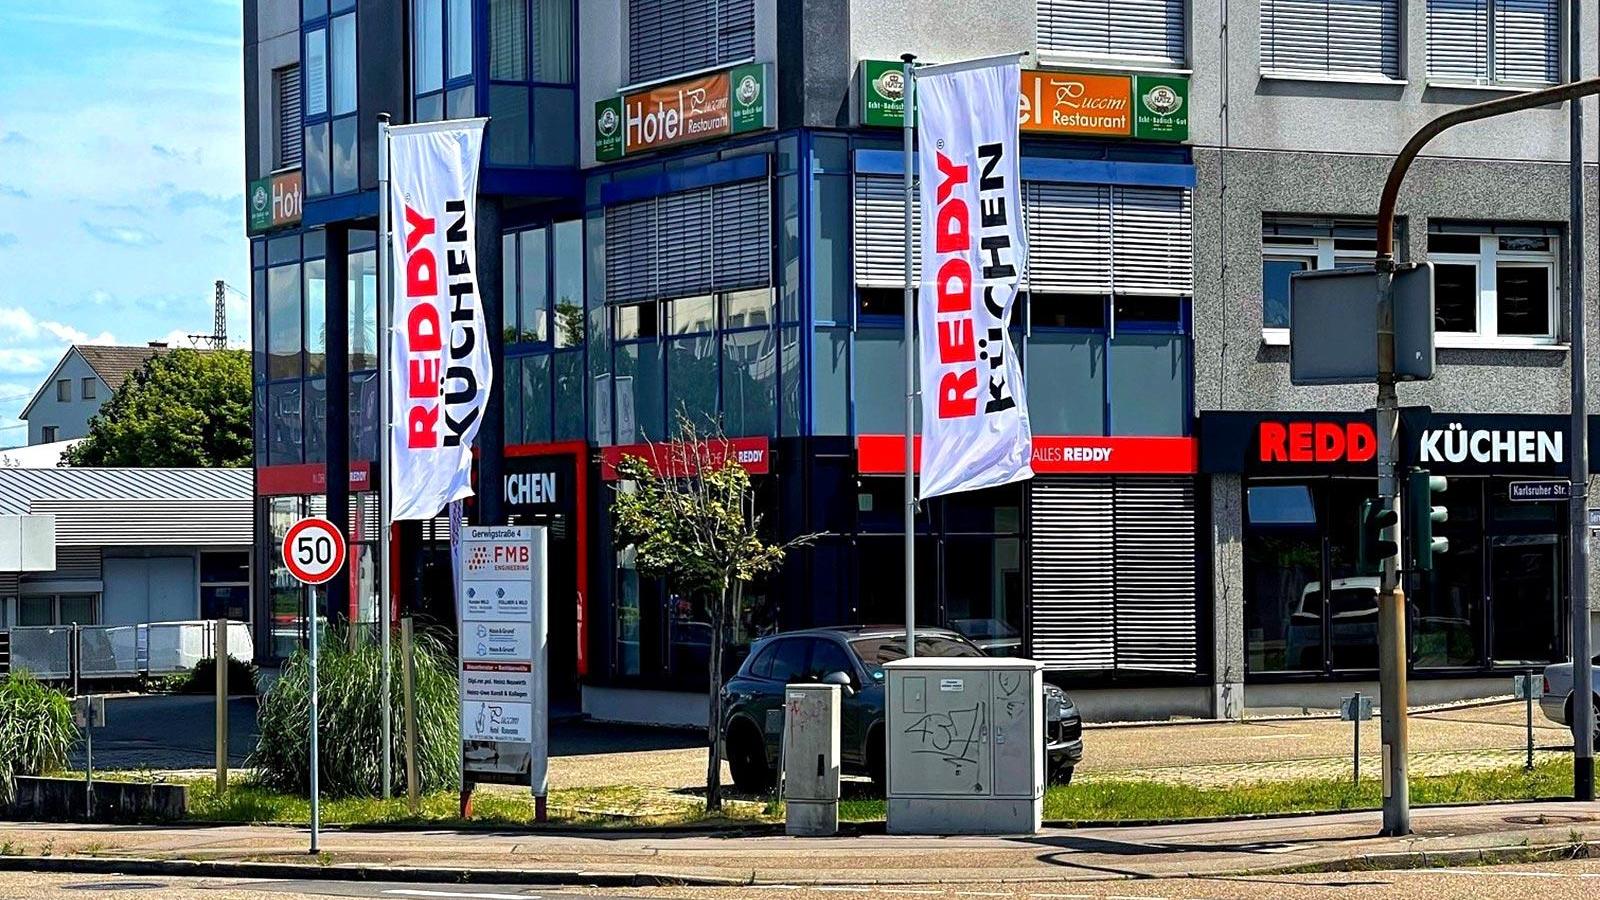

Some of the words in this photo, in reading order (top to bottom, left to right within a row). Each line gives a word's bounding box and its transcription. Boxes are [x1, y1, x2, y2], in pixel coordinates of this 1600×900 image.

[1050, 78, 1127, 110] Puccini
[626, 89, 683, 147] Hotel
[687, 112, 728, 134] Restaurant
[1052, 109, 1126, 128] Restaurant
[273, 182, 302, 220] Hot
[936, 150, 978, 419] REDDY
[405, 203, 442, 449] REDDY
[440, 200, 480, 447] KÜCHEN
[738, 450, 763, 463] REDDY
[1032, 447, 1061, 462] ALLES
[1063, 446, 1112, 462] REDDY
[1259, 421, 1377, 463] REDD
[1420, 422, 1563, 464] KÜCHEN
[504, 472, 556, 505] CHEN
[1513, 484, 1552, 496] Karlsruher
[1553, 484, 1567, 495] Str.
[471, 529, 516, 539] Gerwigstraße
[298, 536, 331, 565] 50
[494, 546, 529, 563] FMB
